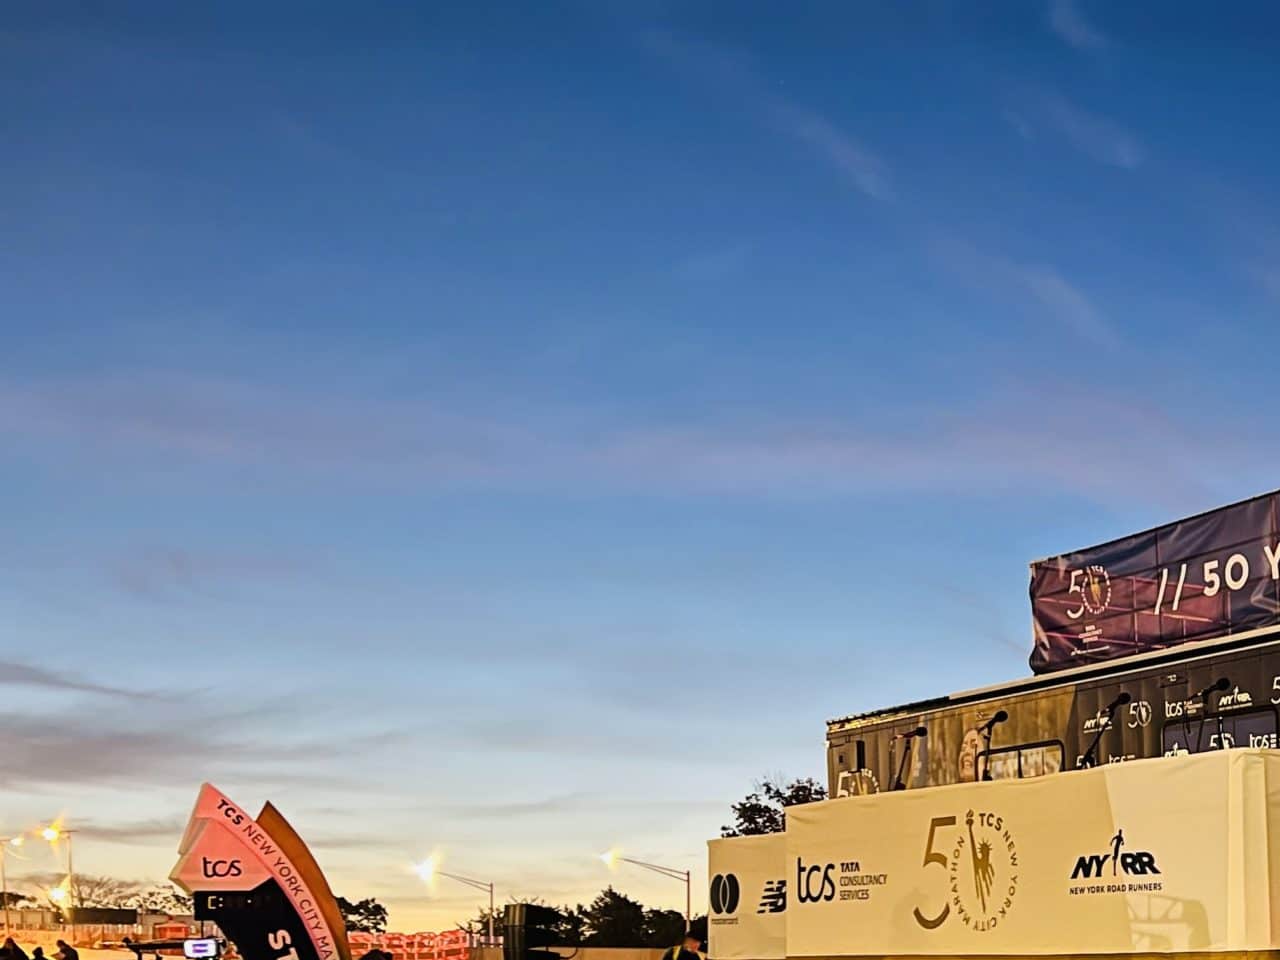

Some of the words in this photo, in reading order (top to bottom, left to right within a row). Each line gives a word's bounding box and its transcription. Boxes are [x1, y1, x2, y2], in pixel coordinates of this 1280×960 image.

[1203, 553, 1249, 597] 50
[1164, 700, 1183, 718] tcs
[978, 812, 1004, 831] TCS
[1002, 830, 1018, 867] NEW
[202, 856, 242, 878] tcs
[217, 799, 244, 825] TCS
[242, 824, 277, 855] NEW
[273, 857, 305, 897] YORK
[299, 899, 323, 931] CITY
[840, 862, 860, 873] TATA
[1070, 848, 1162, 879] NYRR
[797, 856, 836, 903] tcs
[839, 874, 888, 887] CONSULTANCY
[950, 836, 971, 926] MARATHON
[1069, 886, 1086, 895] NEW
[1087, 885, 1106, 894] YORK
[1107, 883, 1127, 893] ROAD
[1128, 882, 1162, 892] RUNNERS
[839, 889, 870, 901] SERVICES
[998, 875, 1018, 919] YORK
[973, 917, 998, 931] CITY
